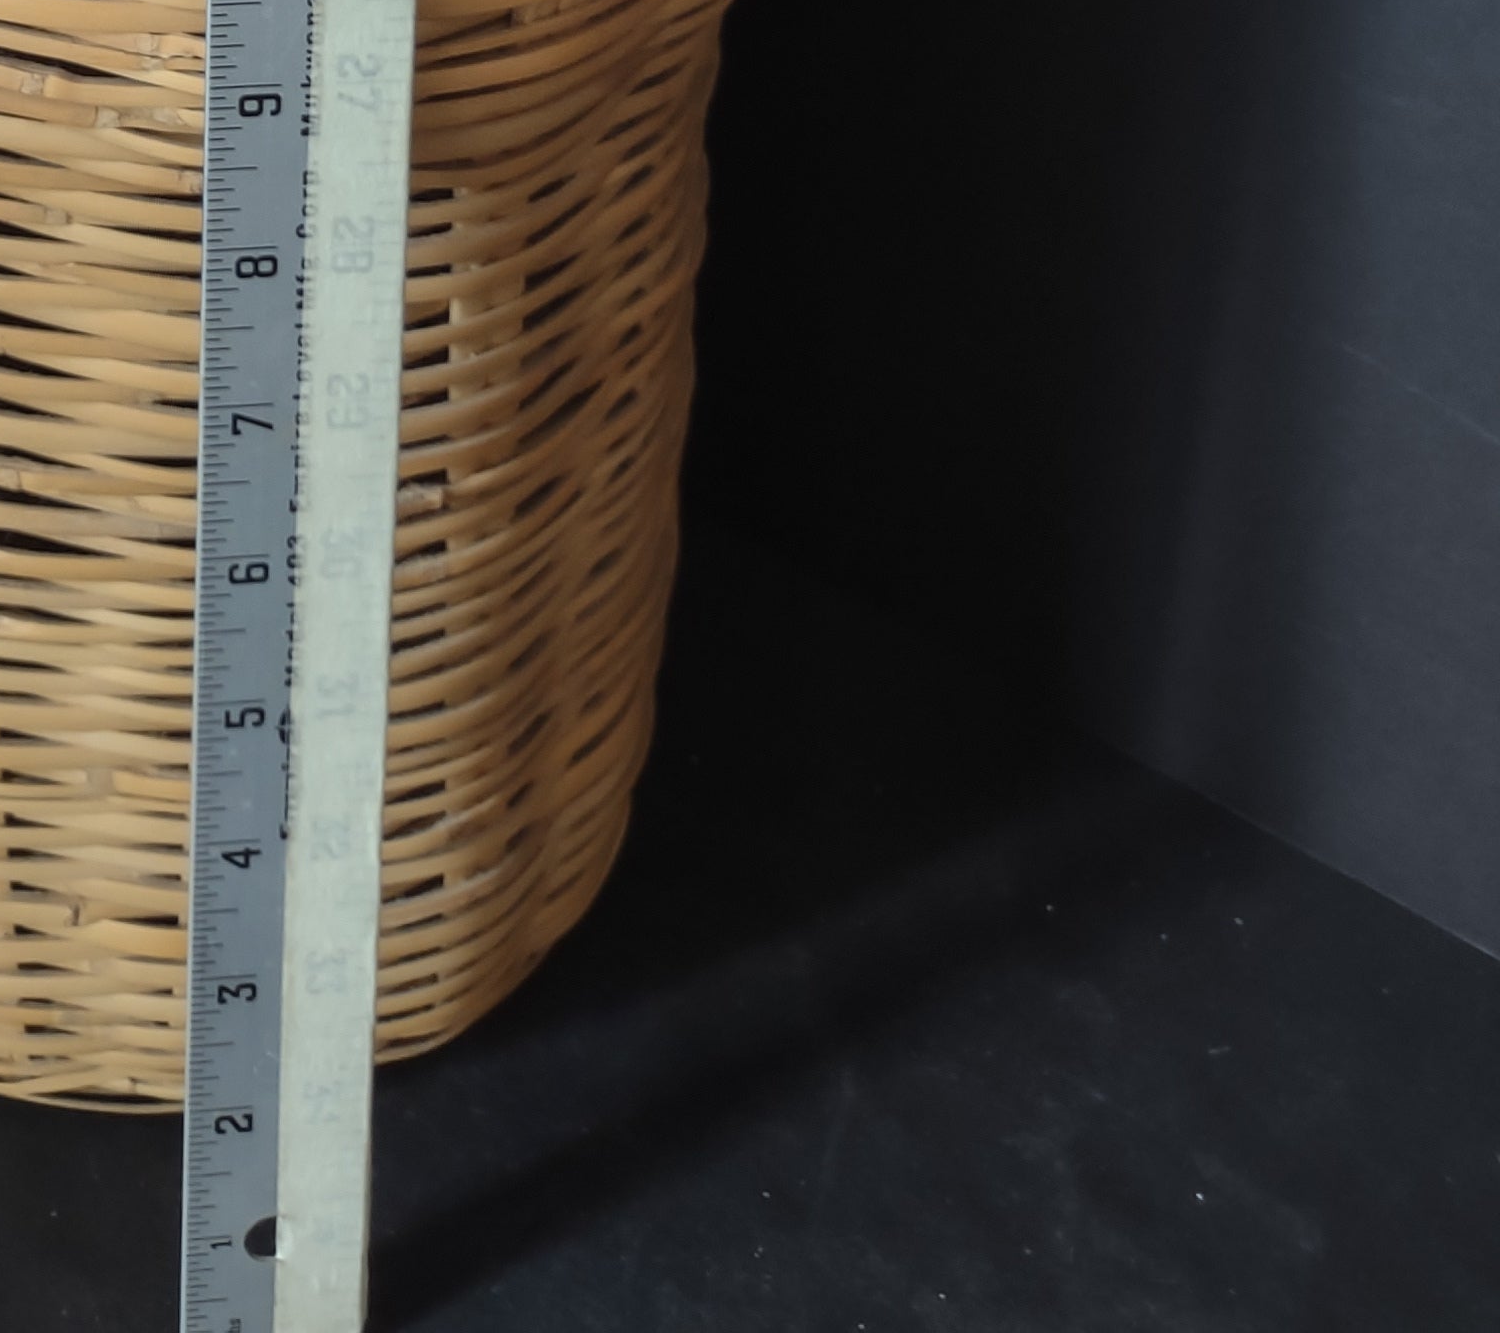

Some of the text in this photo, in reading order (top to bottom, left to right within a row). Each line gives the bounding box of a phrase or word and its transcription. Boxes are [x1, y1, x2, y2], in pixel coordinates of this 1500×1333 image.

[337, 53, 384, 117] 27
[238, 91, 281, 119] 9
[330, 214, 374, 277] 28
[235, 254, 278, 279] 8
[326, 371, 370, 432] 29
[232, 412, 274, 435] 7
[228, 561, 269, 584] 6
[225, 704, 266, 729] 5
[221, 847, 261, 869] 4
[217, 981, 257, 1005] 3
[214, 1113, 254, 1135] 2
[210, 1238, 233, 1250] 1
